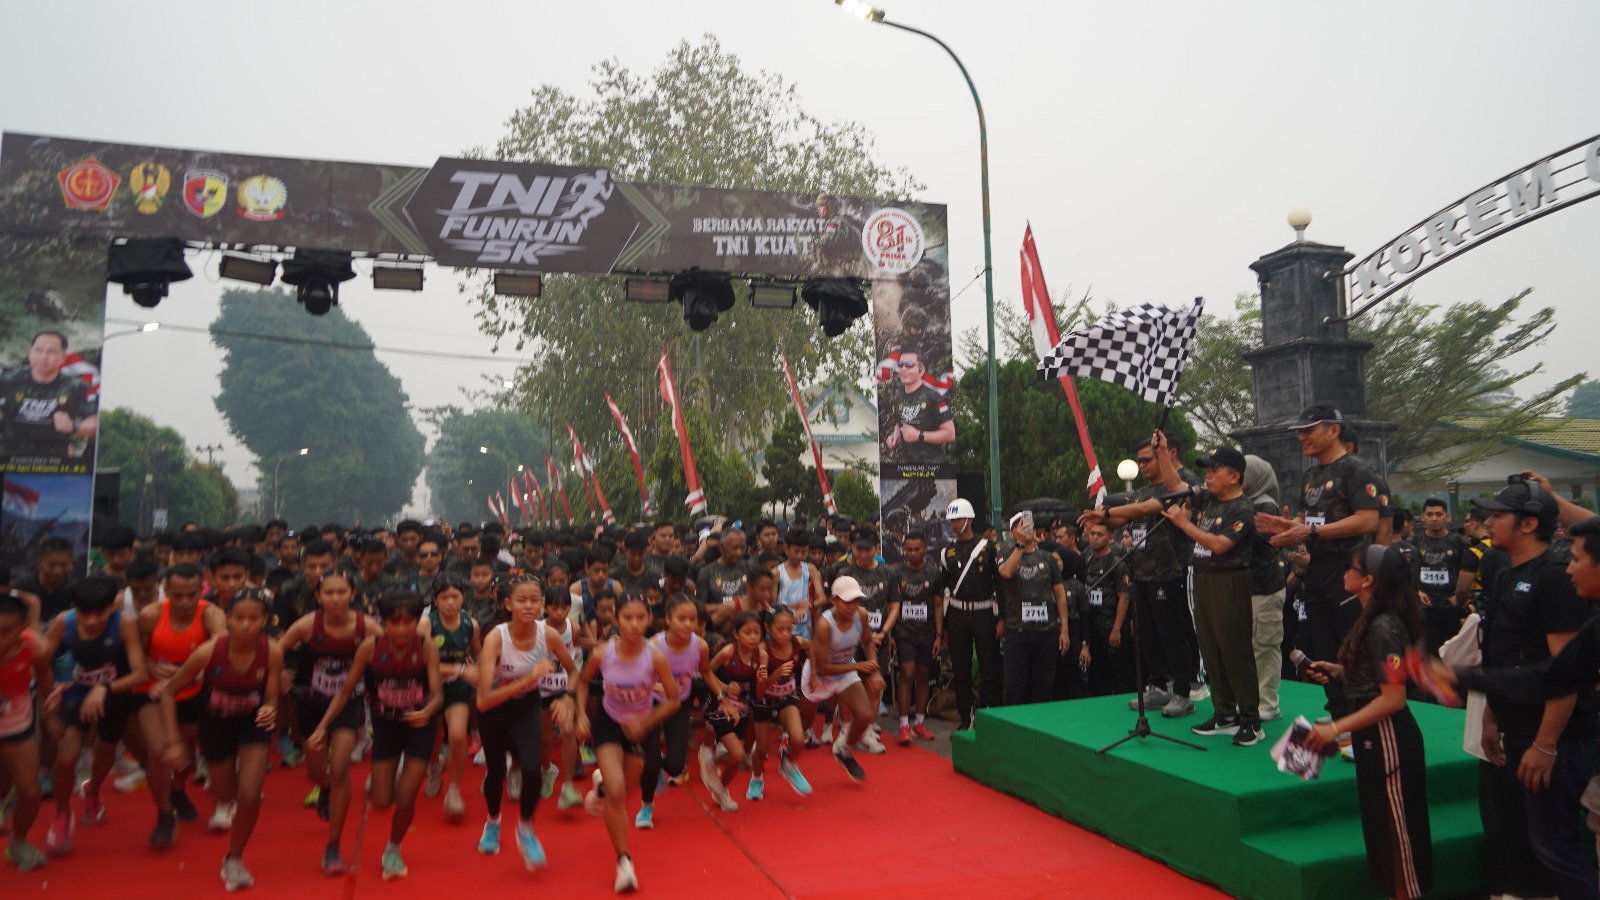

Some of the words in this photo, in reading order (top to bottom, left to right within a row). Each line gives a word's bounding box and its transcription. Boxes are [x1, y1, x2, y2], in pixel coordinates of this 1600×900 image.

[450, 170, 568, 216] TNI
[439, 215, 585, 245] FUNRUN
[693, 217, 763, 234] BERSAMA
[766, 216, 826, 233] RAKYAT
[1356, 159, 1558, 299] KOREM
[476, 239, 541, 265] 5K
[712, 235, 750, 256] TNI
[754, 235, 812, 256] KUAT
[1423, 573, 1445, 581] 2114
[905, 607, 925, 616] 1125
[1025, 608, 1046, 617] 2714
